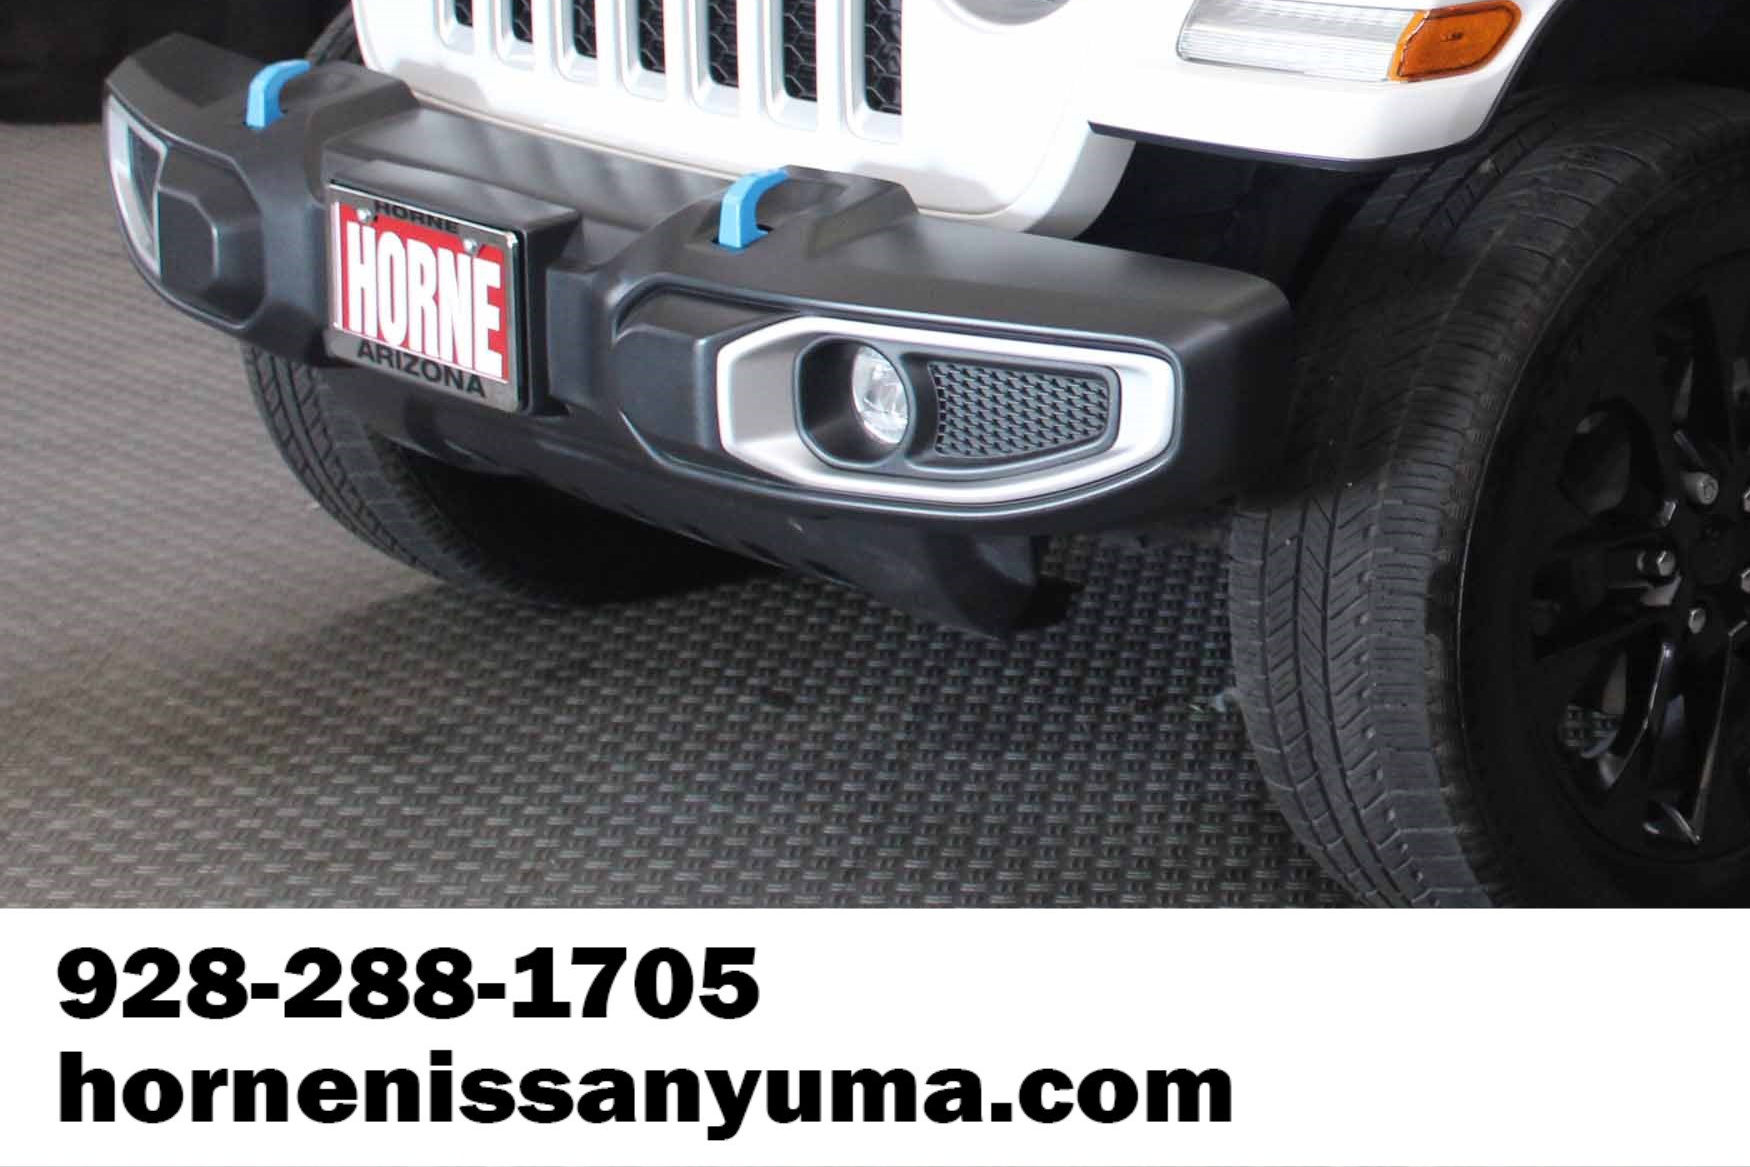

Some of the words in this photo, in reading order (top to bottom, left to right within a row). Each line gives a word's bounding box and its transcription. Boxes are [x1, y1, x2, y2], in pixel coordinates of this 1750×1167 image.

[374, 200, 459, 234] HORNE
[346, 221, 502, 378] HORNE
[357, 340, 486, 398] ARIZONA
